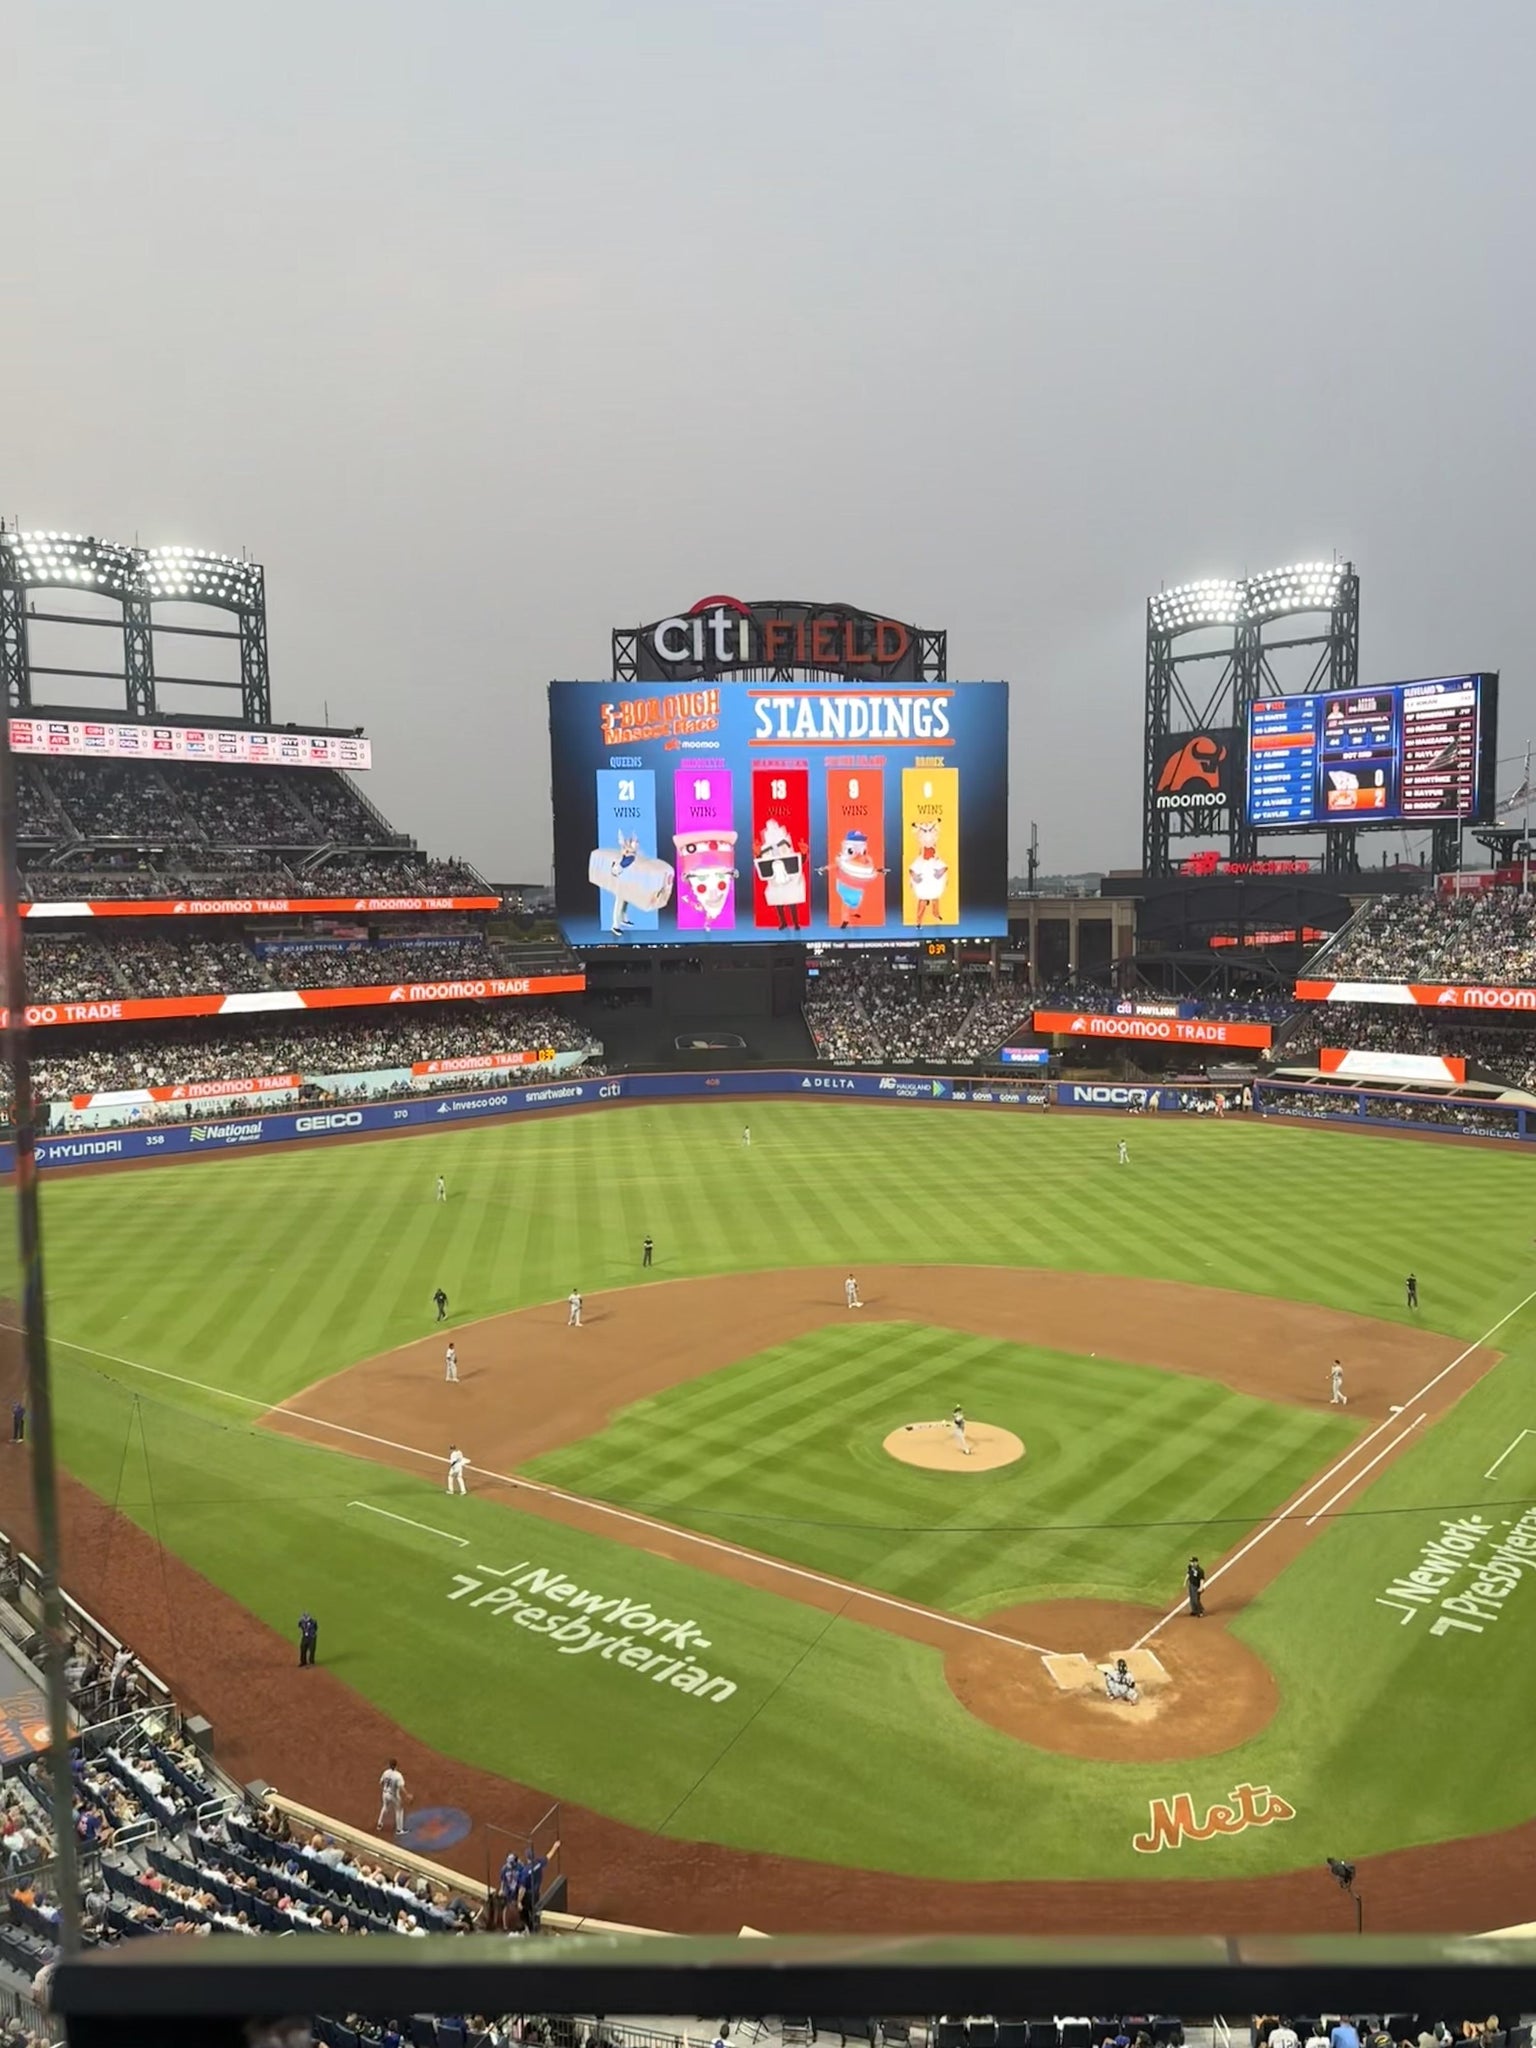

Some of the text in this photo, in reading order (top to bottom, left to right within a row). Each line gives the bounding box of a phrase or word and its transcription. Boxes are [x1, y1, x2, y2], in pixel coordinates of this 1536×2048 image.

[654, 608, 908, 663] citi FIELD
[754, 697, 950, 739] STANDINGS
[51, 736, 69, 744] ATL
[681, 741, 720, 749] moomoo
[610, 756, 643, 768] QUEENS
[1374, 768, 1384, 787] 0
[618, 779, 635, 801] 21
[1374, 787, 1385, 808] 2
[1157, 792, 1226, 808] moomoo
[613, 807, 641, 818] WINS
[690, 806, 717, 818] WINS
[842, 805, 869, 817] WINS
[917, 804, 943, 816] WINS
[190, 901, 289, 913] moomoo TRADE
[368, 898, 453, 910] moomoo TRADE
[410, 980, 530, 1000] moomoo TRADE
[64, 1003, 123, 1020] TRADE
[1137, 1006, 1176, 1017] PAVILION
[1090, 1018, 1226, 1041] moomoo TRADE
[440, 1054, 523, 1071] moomoo TRADE
[189, 1075, 293, 1096] moomoo TRADE
[599, 1083, 621, 1098] citi
[814, 1078, 855, 1089] DELTA
[525, 1086, 576, 1102] smartwater
[452, 1100, 488, 1111] Invesco
[1278, 1107, 1327, 1119] CADILLAC
[296, 1111, 363, 1132] GEICO
[393, 1109, 409, 1120] 370
[206, 1121, 263, 1139] National
[1462, 1126, 1520, 1139] CADILLAC
[146, 1135, 165, 1145] 358
[49, 1140, 122, 1159] HYUNDAI
[468, 1587, 738, 1703] Presbyterian
[1132, 1782, 1297, 1853] Mets
